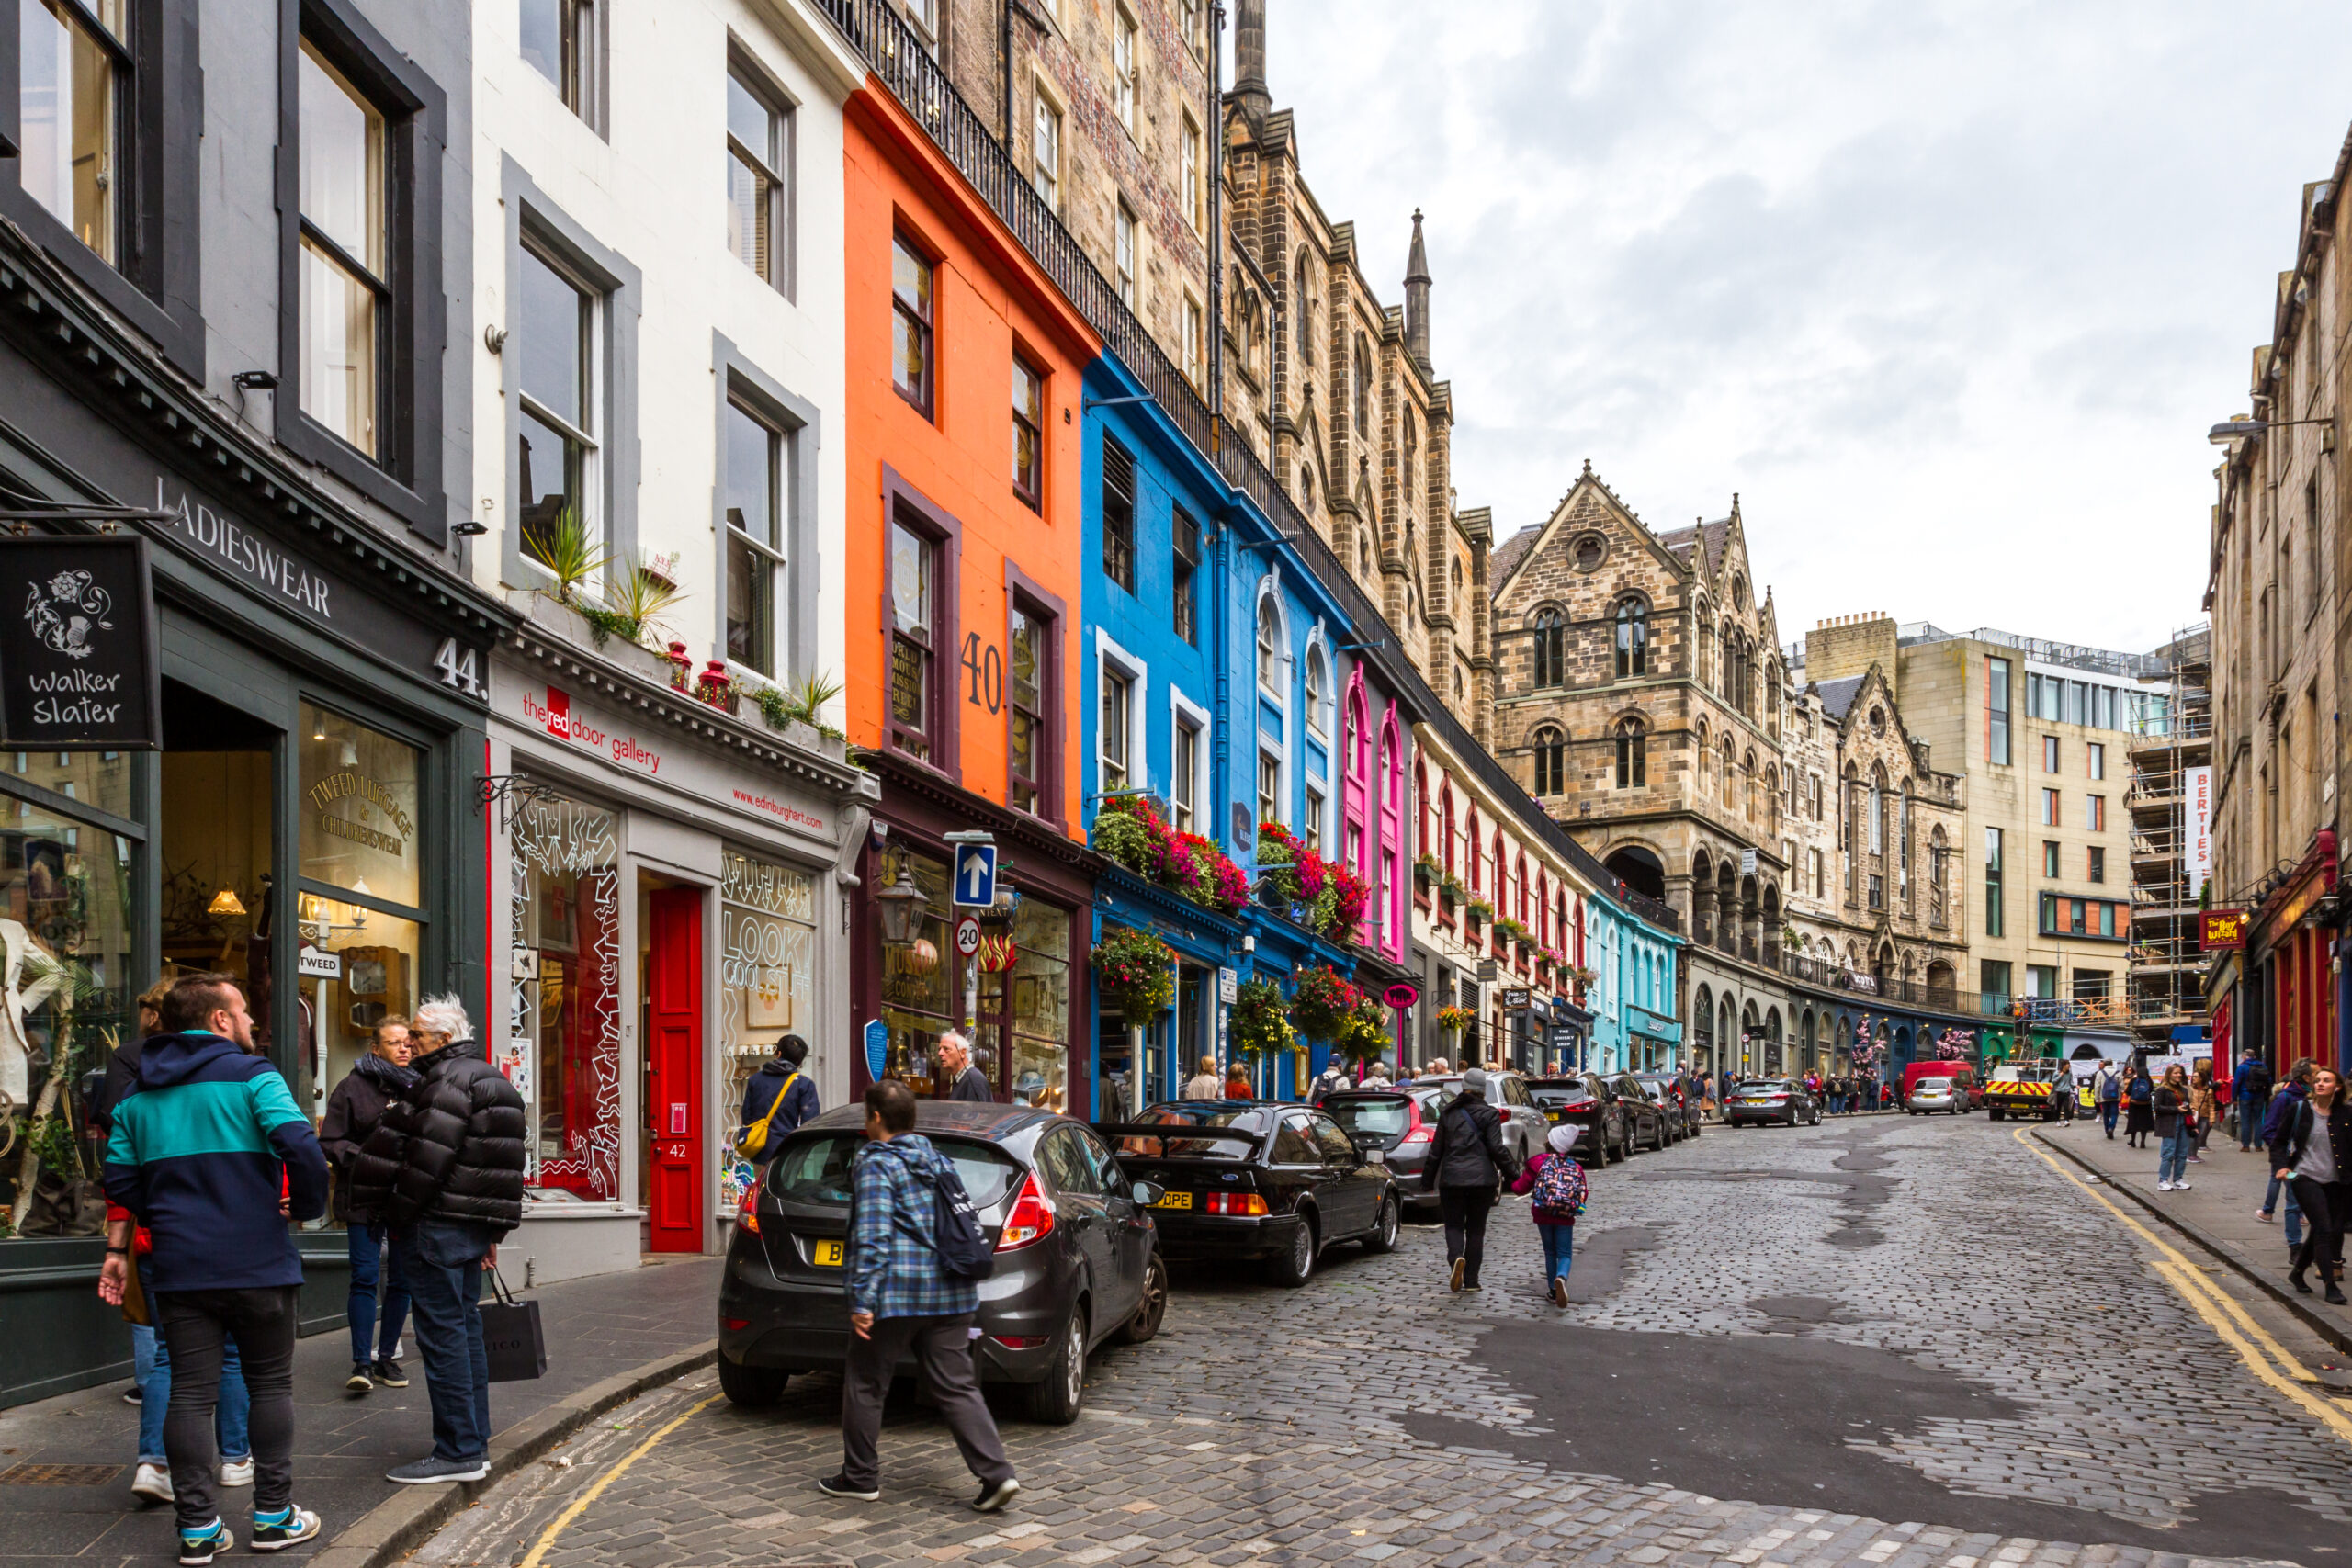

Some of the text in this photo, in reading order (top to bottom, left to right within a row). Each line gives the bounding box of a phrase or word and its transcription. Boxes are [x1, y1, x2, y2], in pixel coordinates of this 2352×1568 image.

[157, 476, 331, 618] LADIESWEAR
[892, 656, 918, 680] MOUS
[961, 631, 1002, 716] 40
[892, 687, 917, 710] REE!
[523, 692, 661, 774] the red door gallery
[308, 772, 414, 842] TWEED LUGGAGE
[732, 788, 823, 830] www.edinburghart.com
[2197, 774, 2208, 862] BERTIES
[322, 813, 403, 858] CHILDRENSWEAR
[959, 929, 978, 947] 20
[2219, 919, 2237, 931] Boy
[300, 956, 337, 971] TWEED
[669, 1144, 686, 1158] 42
